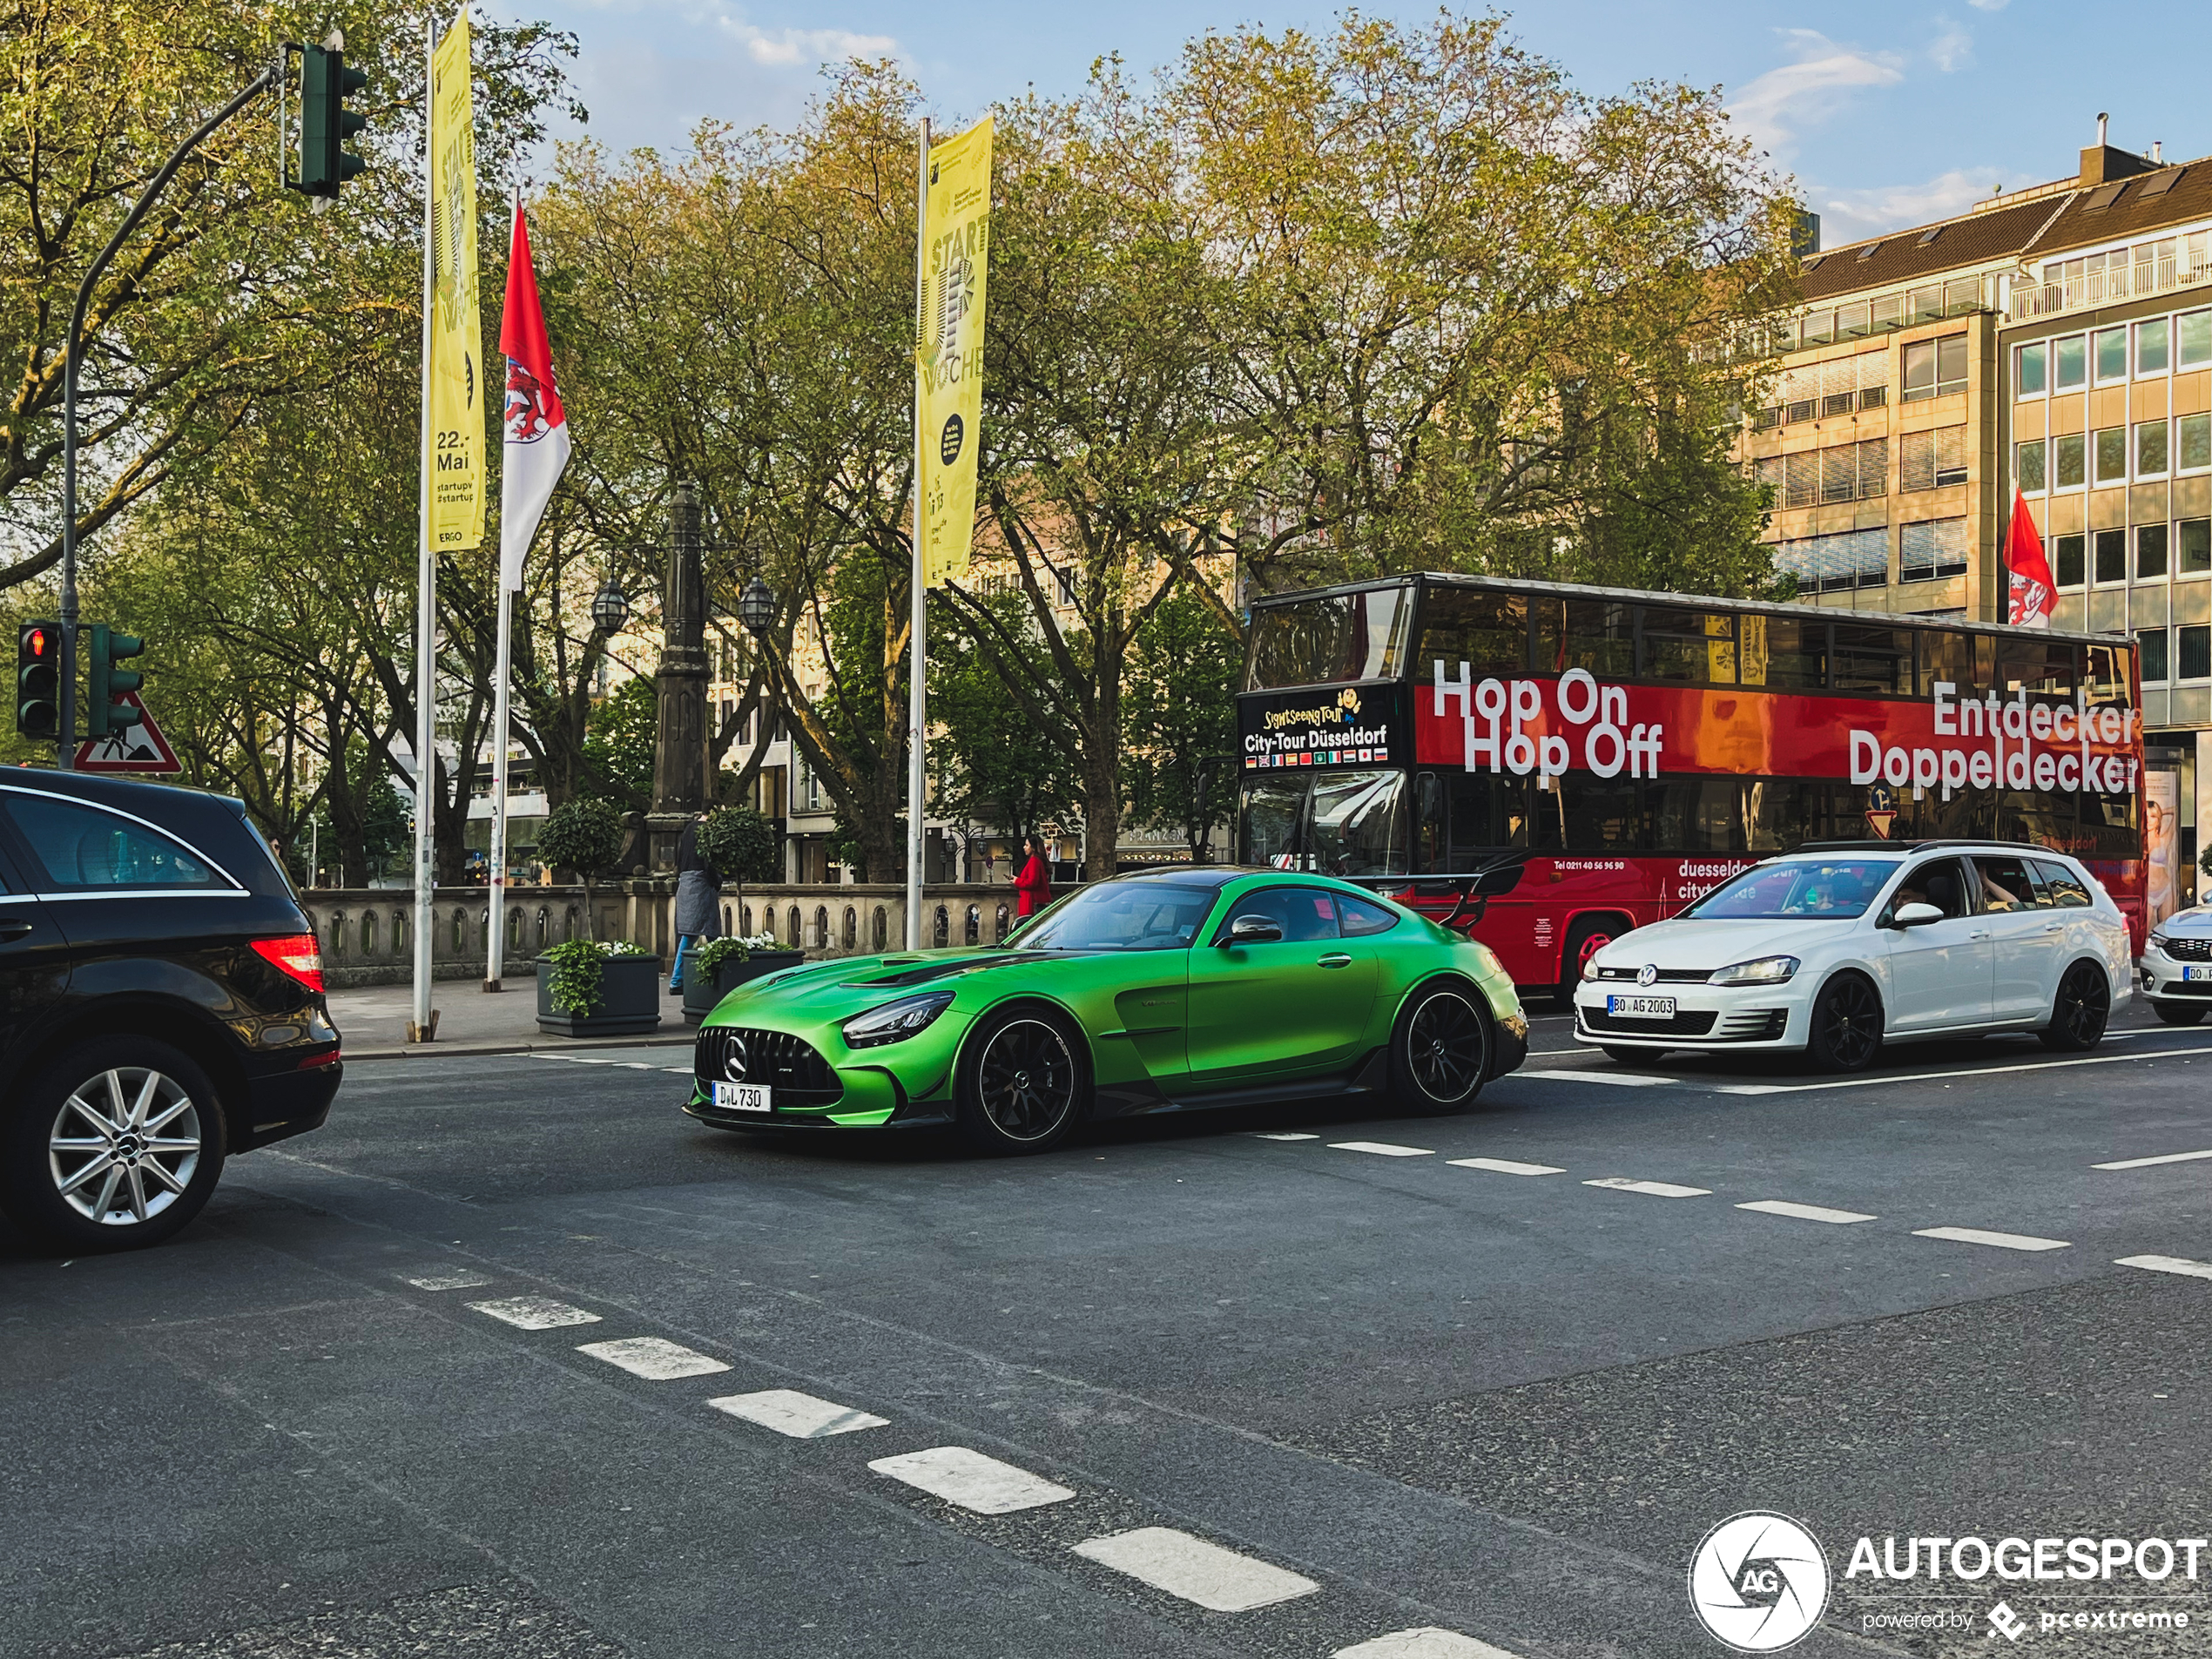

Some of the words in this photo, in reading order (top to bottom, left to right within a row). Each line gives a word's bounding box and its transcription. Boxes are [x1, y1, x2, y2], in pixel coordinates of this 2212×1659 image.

[932, 214, 988, 275] START
[437, 451, 469, 472] Mai
[439, 531, 462, 543] ERGO
[1433, 659, 1541, 738] Hop
[1557, 667, 1628, 725] On
[1933, 681, 2140, 745] Entdecker
[1244, 732, 1306, 755] City-Tour
[1308, 725, 1387, 749] Düsseldorf
[1464, 716, 1570, 790] Hop
[1585, 723, 1663, 779] Off
[1849, 730, 2139, 802] Doppeldecker
[1554, 860, 1566, 870] Tel
[1566, 861, 1582, 870] 0211
[1582, 861, 1593, 870] 40
[1594, 861, 1603, 870] 56
[1604, 861, 1614, 870] 96
[1614, 861, 1624, 870] 90
[2190, 968, 2202, 980] DO
[1614, 998, 1626, 1011] BO
[1633, 999, 1645, 1012] AG
[1648, 1000, 1673, 1014] 2003
[720, 1086, 726, 1104] D
[731, 1088, 738, 1105] L
[739, 1089, 761, 1108] 730
